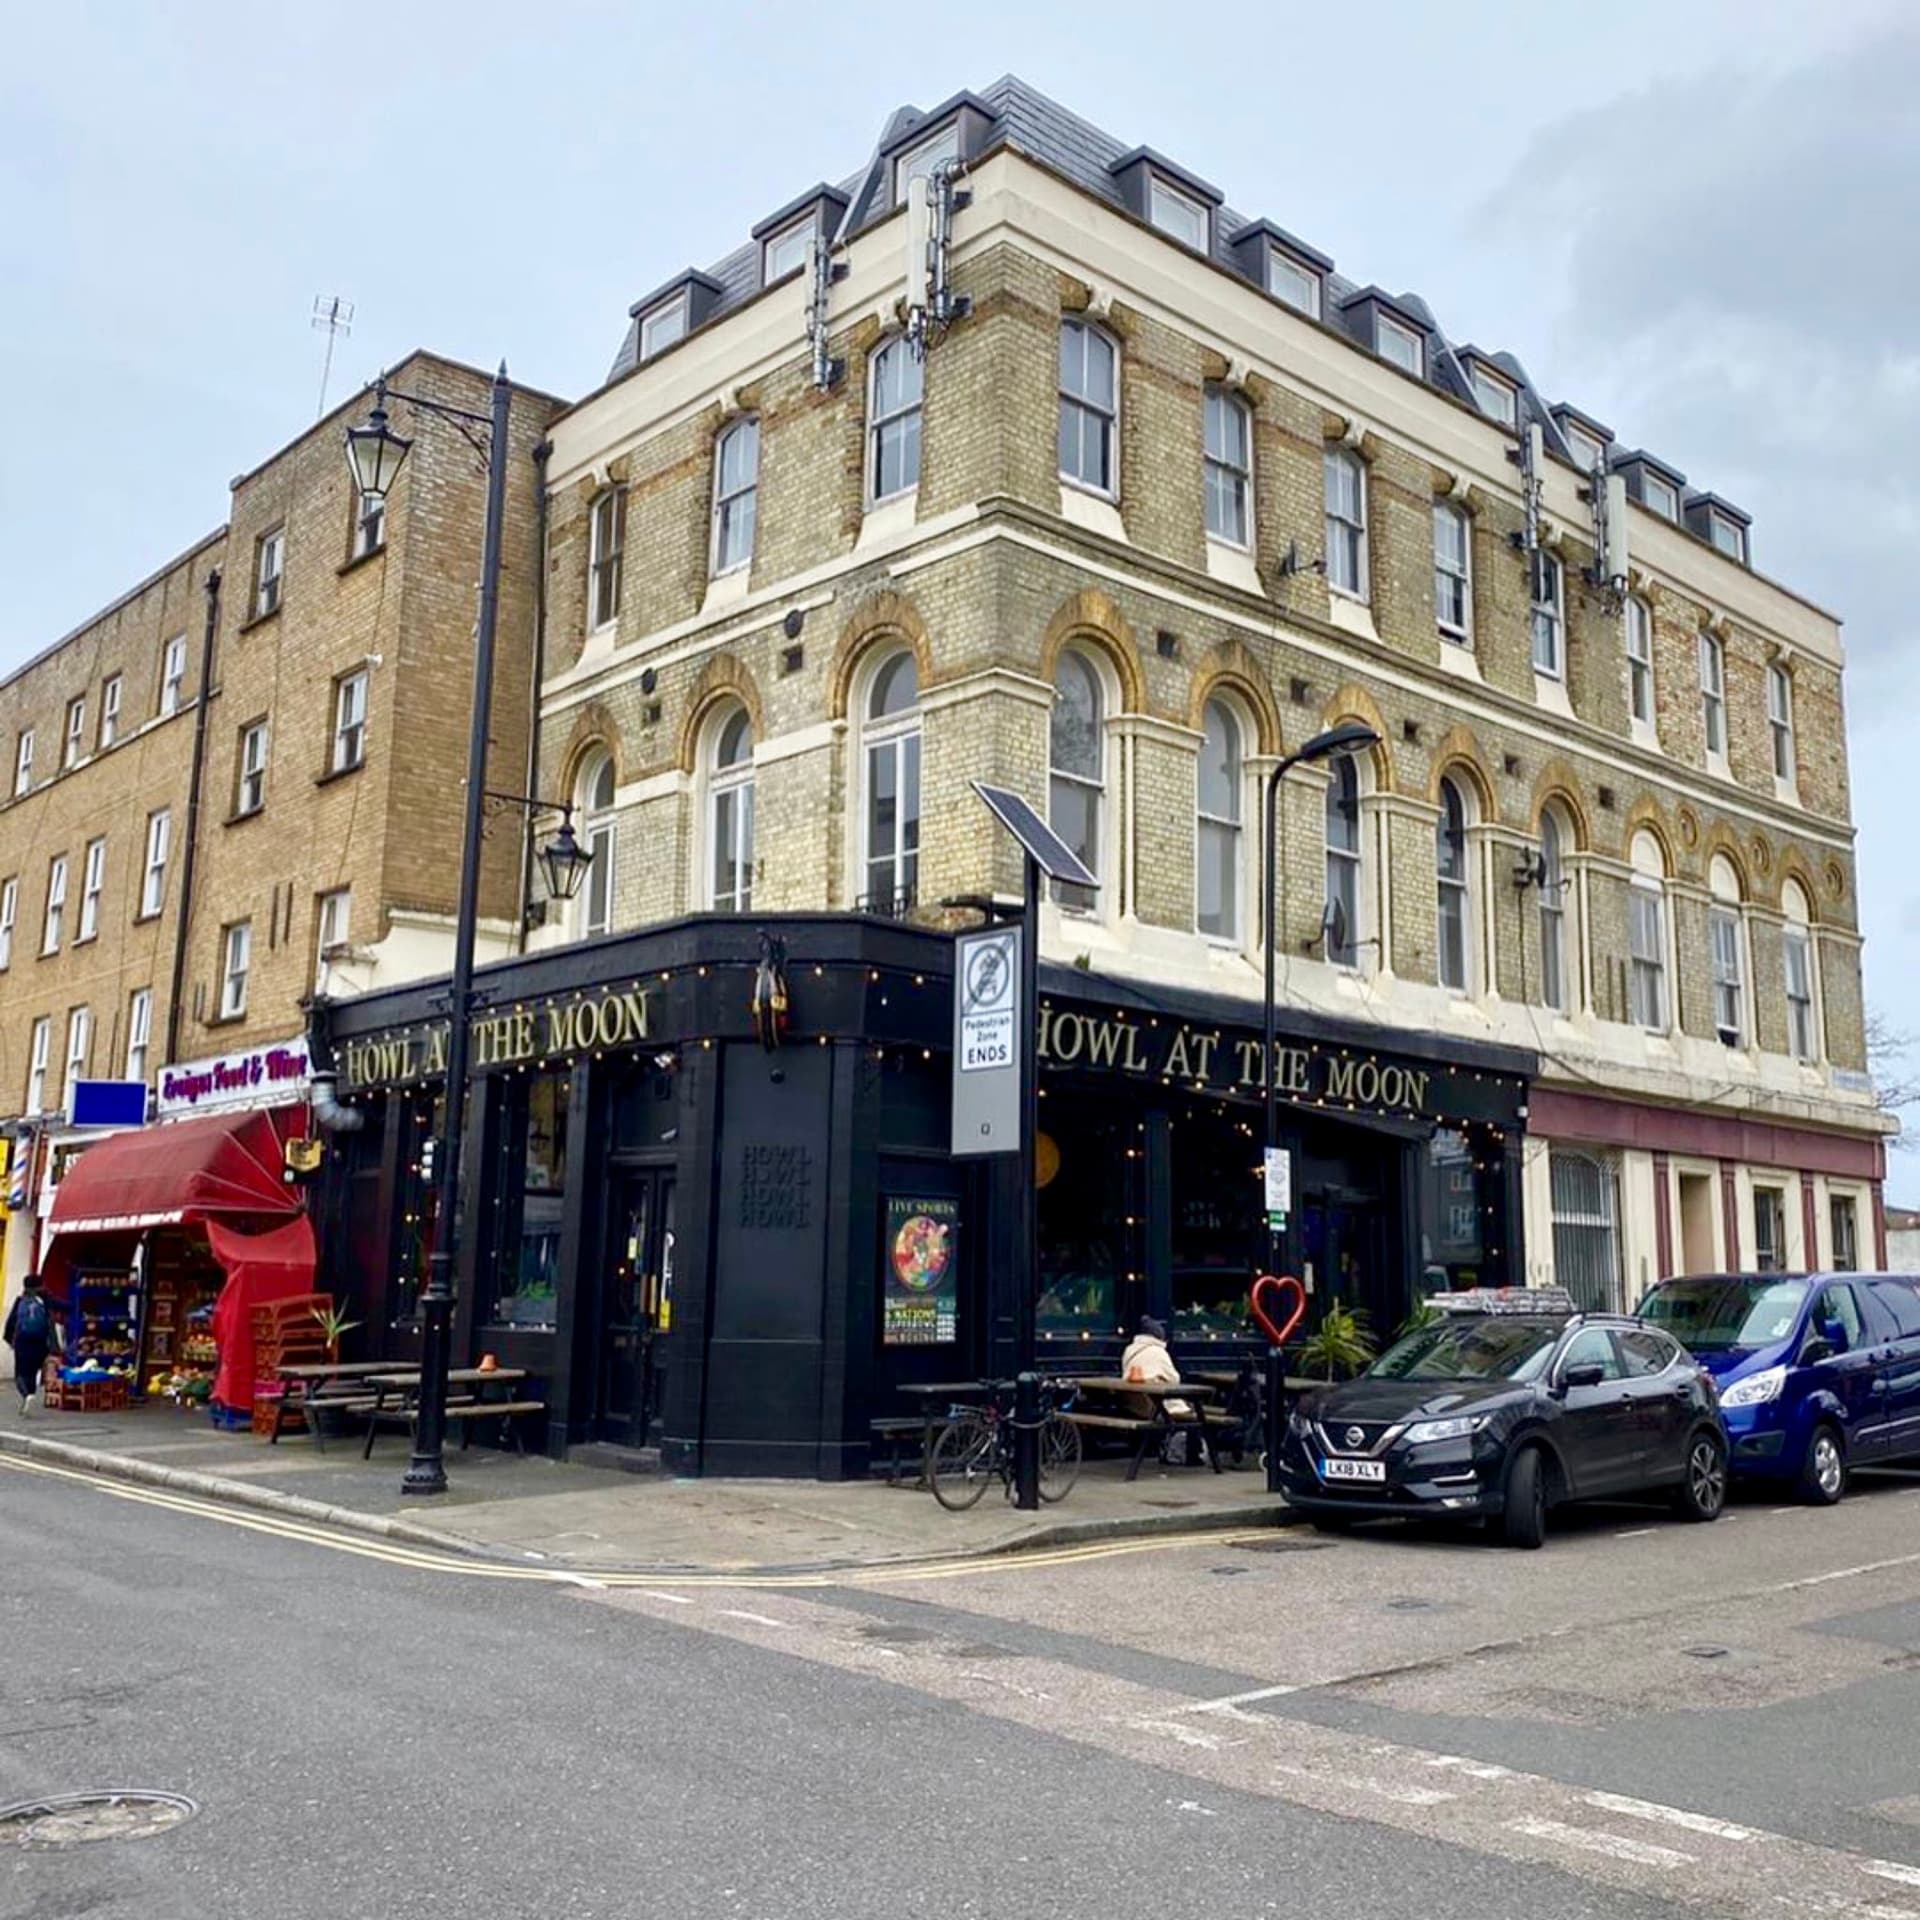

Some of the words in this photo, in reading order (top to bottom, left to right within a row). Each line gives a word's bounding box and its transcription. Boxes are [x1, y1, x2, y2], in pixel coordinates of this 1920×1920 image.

[966, 1017, 1009, 1030] Pedestrian
[347, 1041, 416, 1086] HOWL
[473, 1011, 536, 1066] THE
[547, 991, 650, 1053] MOON
[977, 1031, 997, 1042] Zone
[968, 1044, 1007, 1064] ENDS
[250, 1055, 263, 1084] &
[1163, 1031, 1218, 1081] AT
[1234, 1040, 1310, 1093] THE
[1326, 1056, 1430, 1110] MOON
